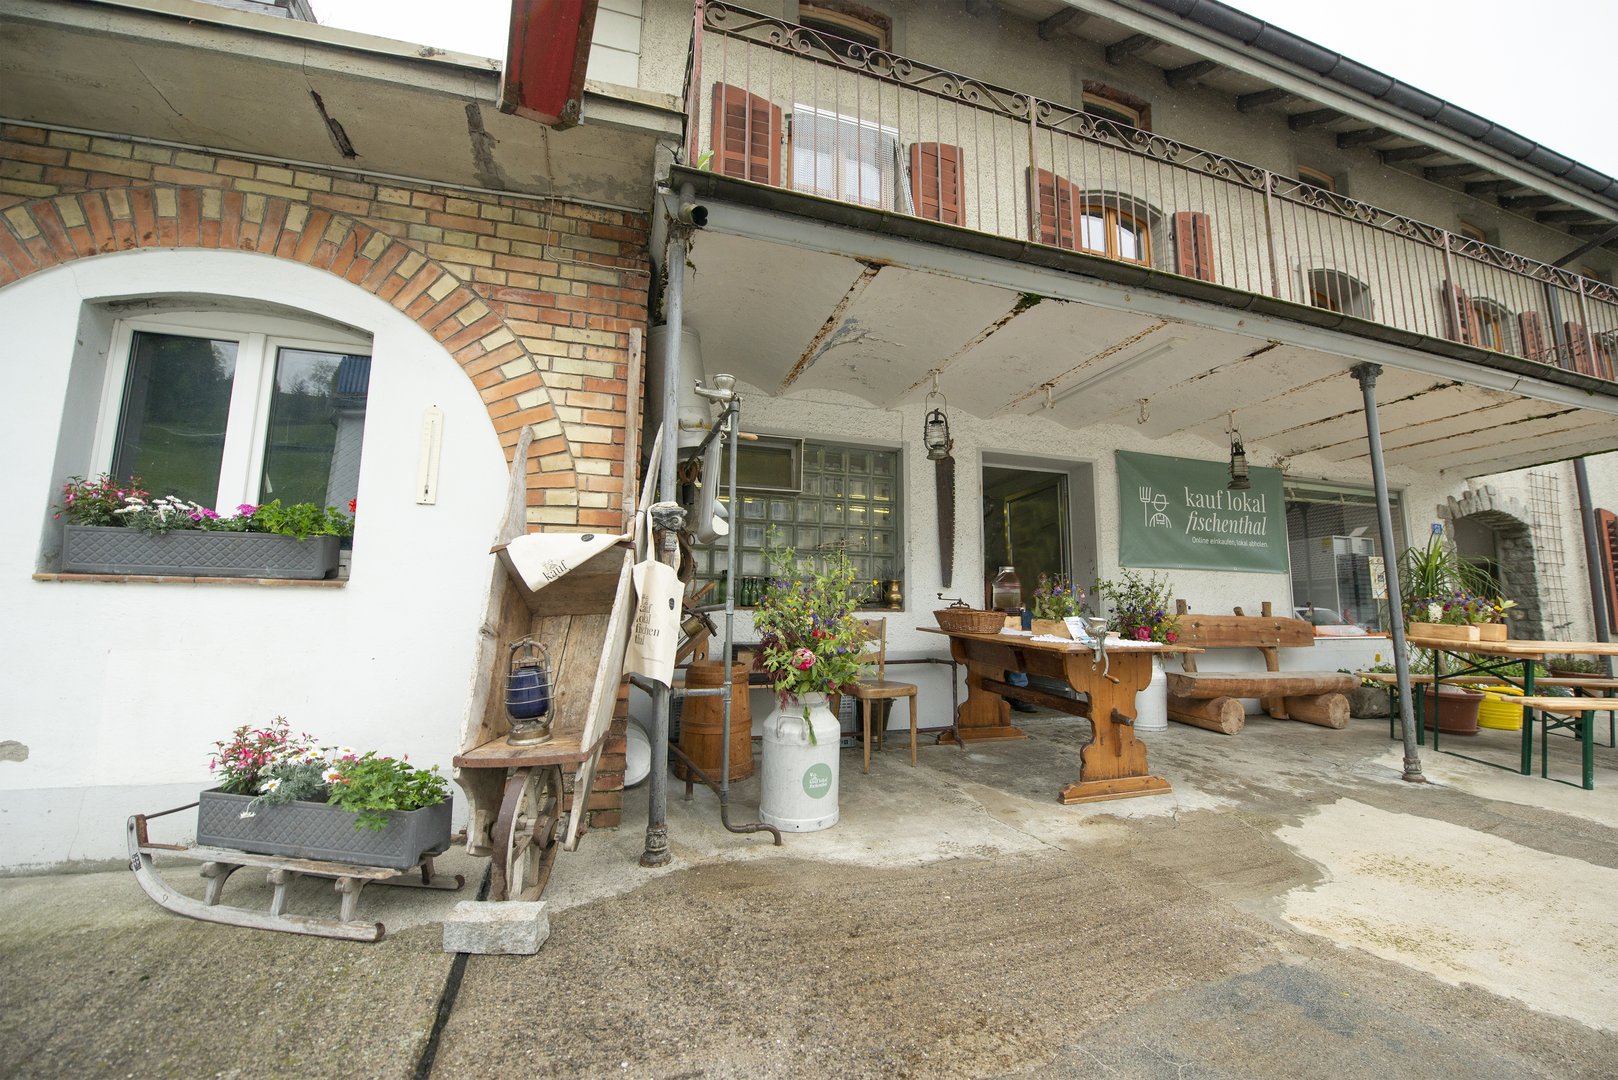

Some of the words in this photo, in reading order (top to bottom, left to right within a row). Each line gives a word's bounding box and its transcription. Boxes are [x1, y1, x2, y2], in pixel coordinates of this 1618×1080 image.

[1184, 486, 1223, 510] kauf
[1227, 491, 1266, 513] lokal
[1185, 511, 1267, 536] fischenthal
[1191, 536, 1209, 545] Online
